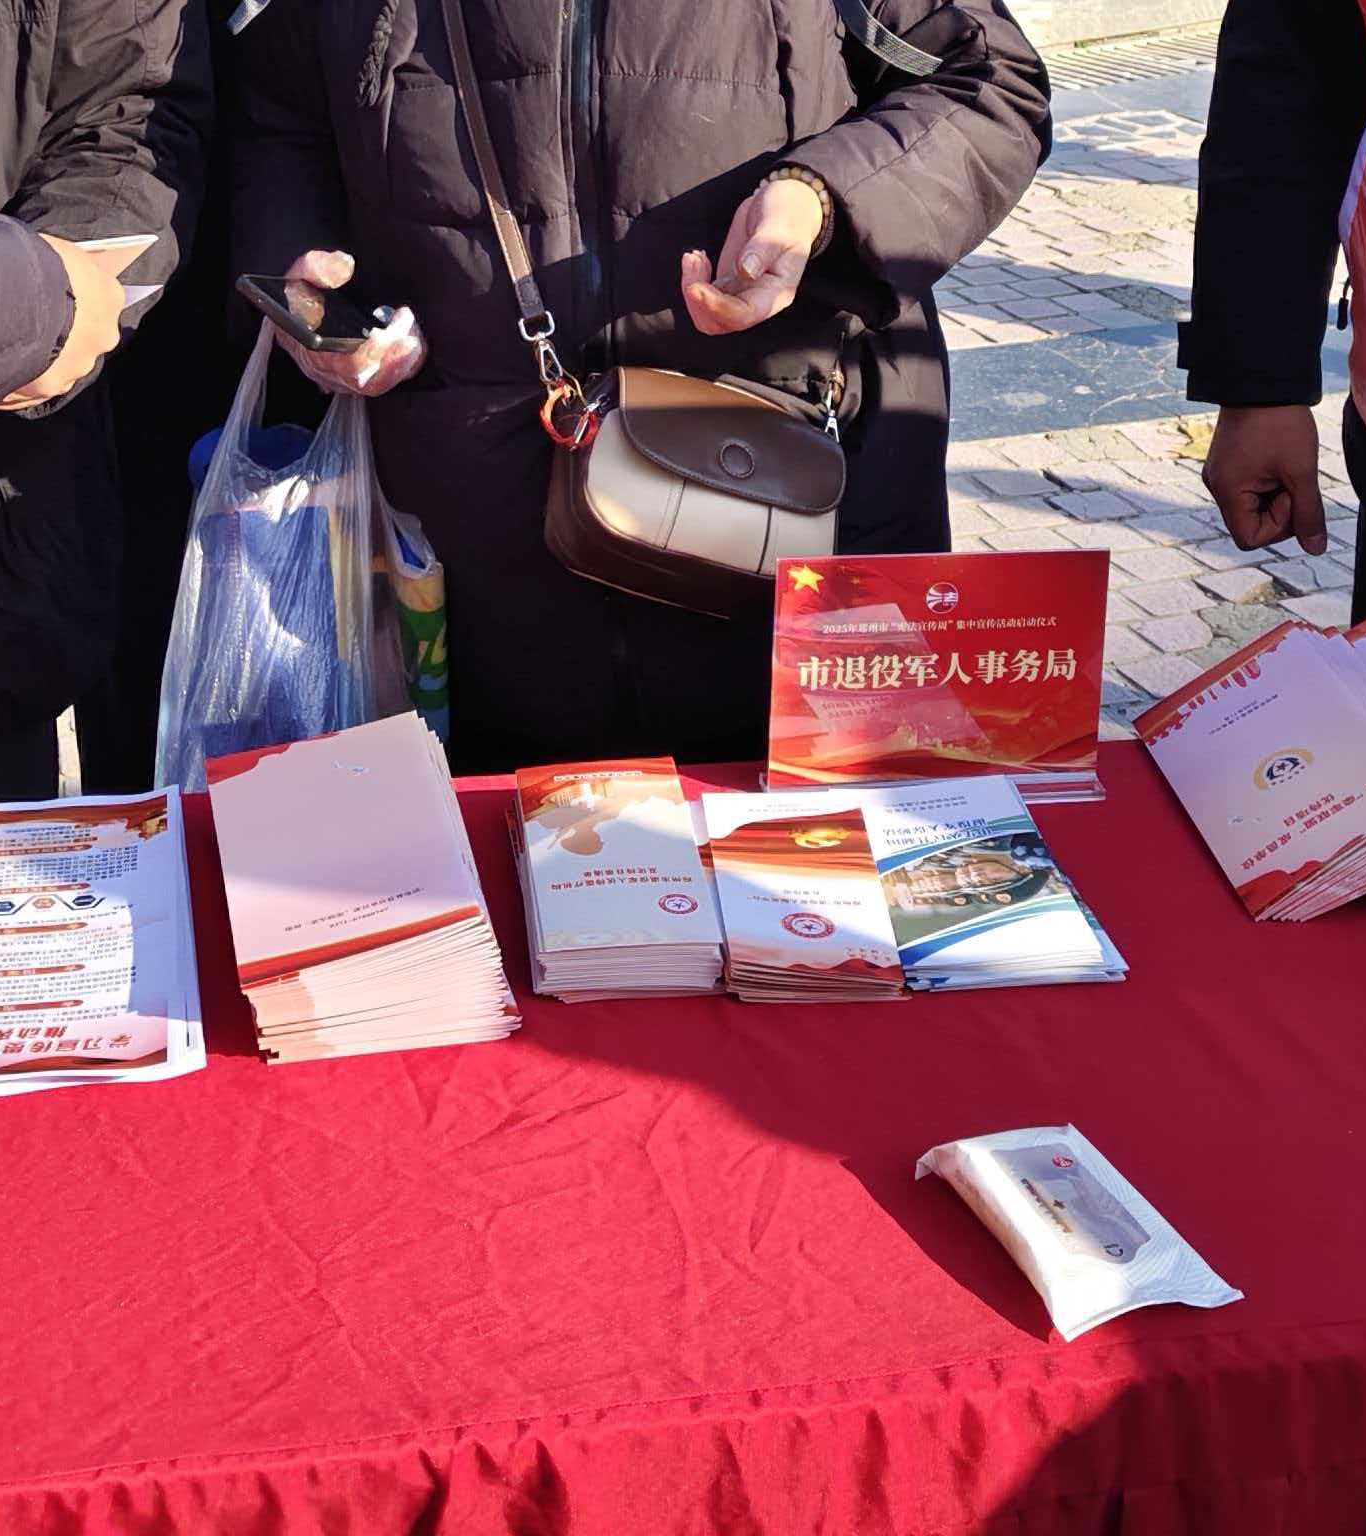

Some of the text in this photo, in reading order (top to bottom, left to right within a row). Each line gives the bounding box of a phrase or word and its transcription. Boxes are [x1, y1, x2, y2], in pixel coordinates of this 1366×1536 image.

[797, 647, 1078, 691] 市退役军人事务局
